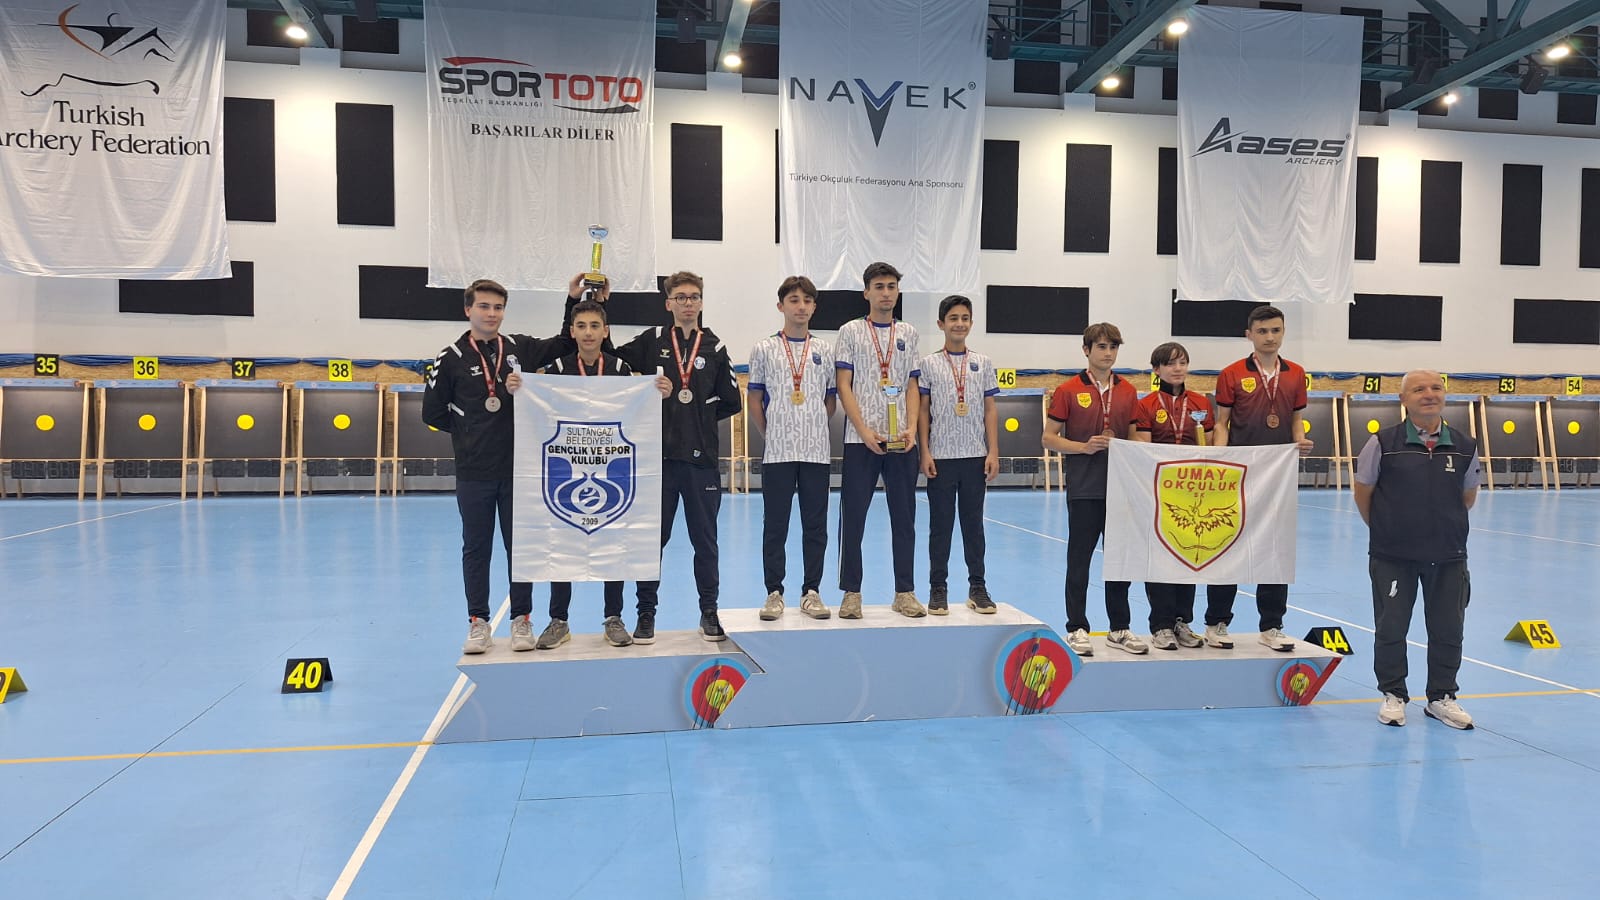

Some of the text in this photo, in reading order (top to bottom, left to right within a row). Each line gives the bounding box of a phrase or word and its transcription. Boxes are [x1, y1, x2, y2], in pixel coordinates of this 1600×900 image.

[53, 100, 145, 127] Turkish
[471, 123, 615, 141] BAŞARILAR DİLER
[91, 130, 211, 156] Federation
[1285, 157, 1343, 166] ARCHERY
[820, 174, 853, 184] Okçuluk
[855, 176, 906, 187] Federasyonu
[908, 179, 924, 187] Ana
[926, 180, 964, 189] Sponsoru
[36, 357, 57, 374] 35
[137, 360, 155, 375] 36
[234, 361, 253, 377] 37
[331, 363, 349, 378] 38
[999, 371, 1014, 385] 46
[1365, 377, 1379, 391] 51
[1500, 378, 1515, 392] 53
[1568, 380, 1581, 393] 54
[590, 446, 603, 455] VE
[605, 446, 631, 455] SPOR
[1177, 468, 1227, 481] UMAY
[1163, 479, 1238, 492] OKÇULUK
[581, 518, 599, 526] 2009
[1322, 629, 1349, 652] 44
[1529, 623, 1555, 645] 45
[287, 661, 322, 689] 40
